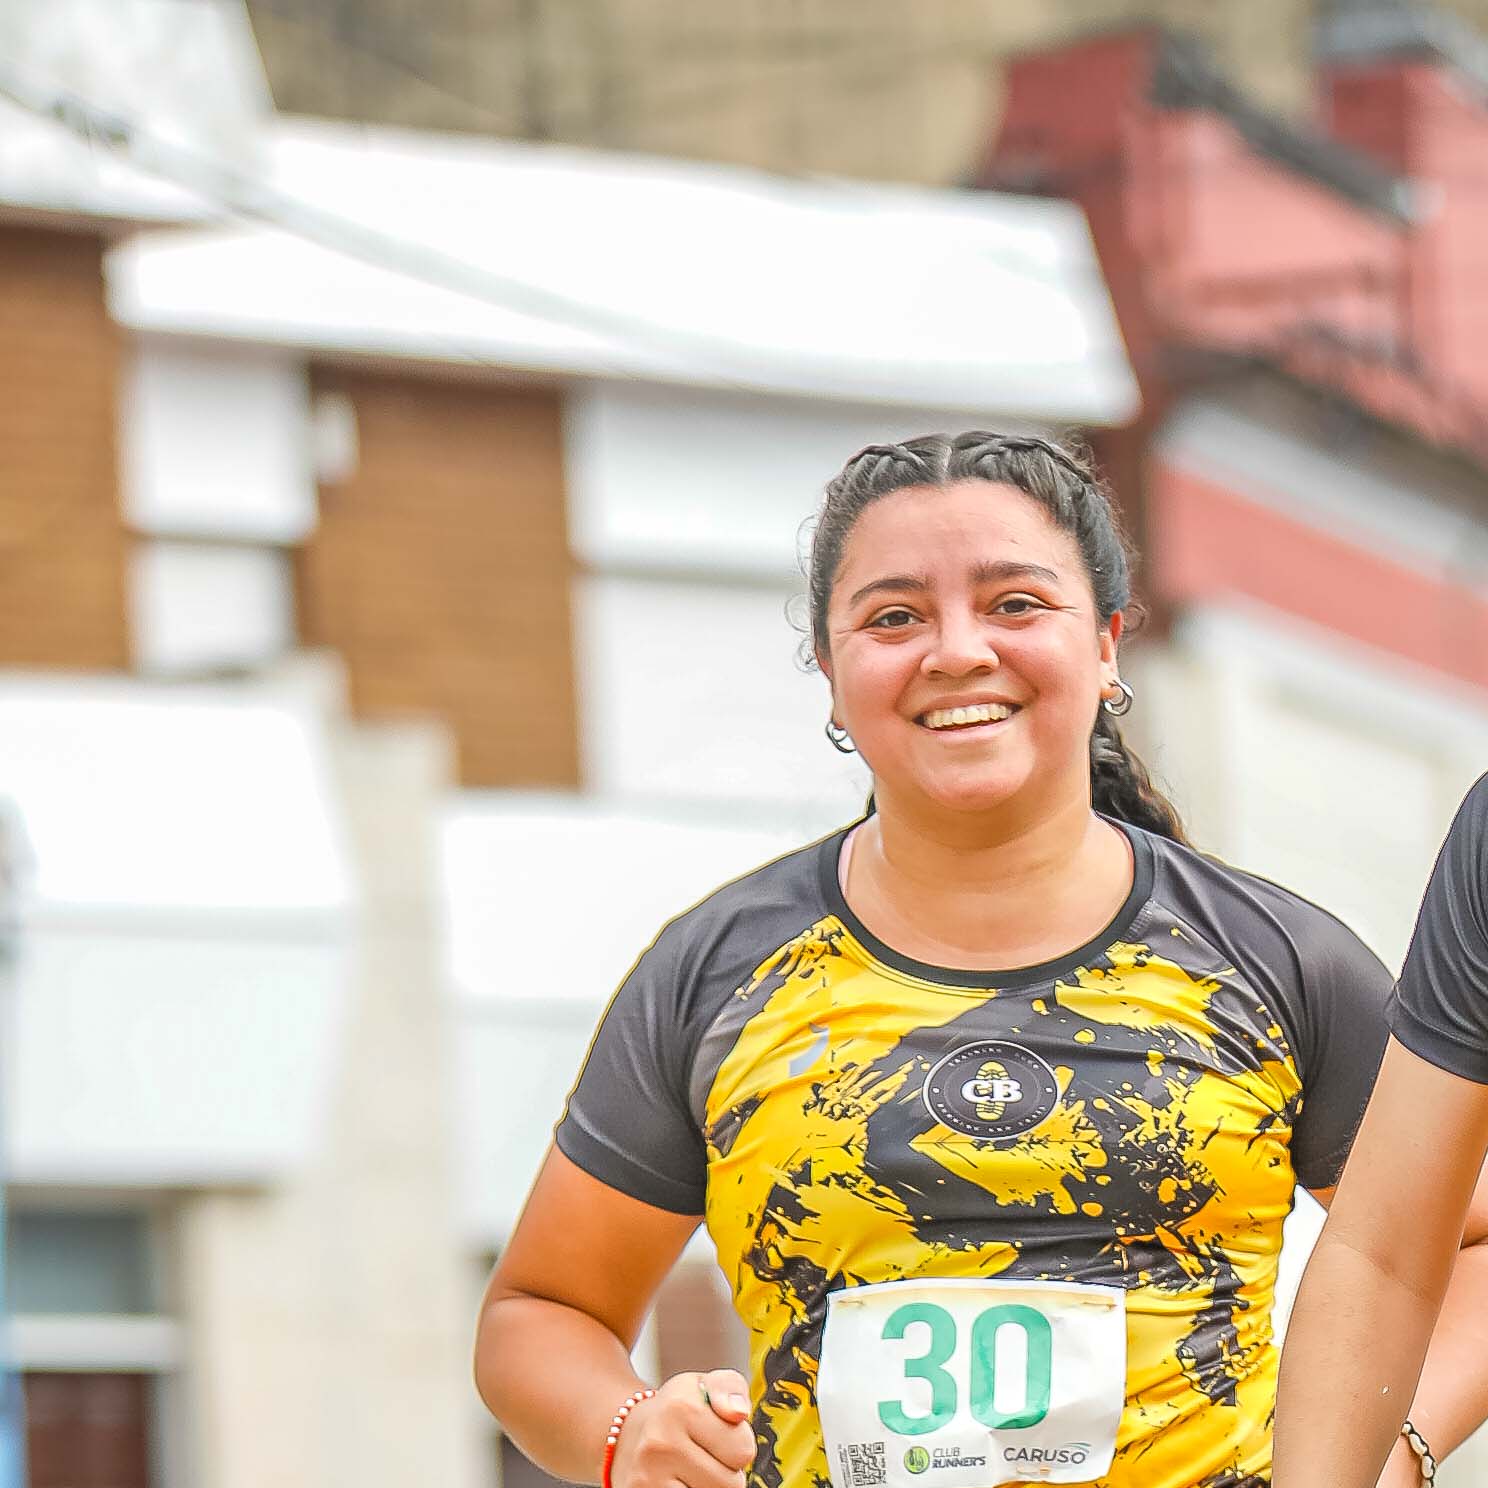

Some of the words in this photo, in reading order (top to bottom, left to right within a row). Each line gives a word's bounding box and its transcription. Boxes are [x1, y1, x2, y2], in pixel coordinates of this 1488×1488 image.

[960, 1079, 1023, 1103] CB
[877, 1302, 1053, 1436] 30
[932, 1447, 960, 1458] CLUB
[1003, 1447, 1086, 1464] CARUSO
